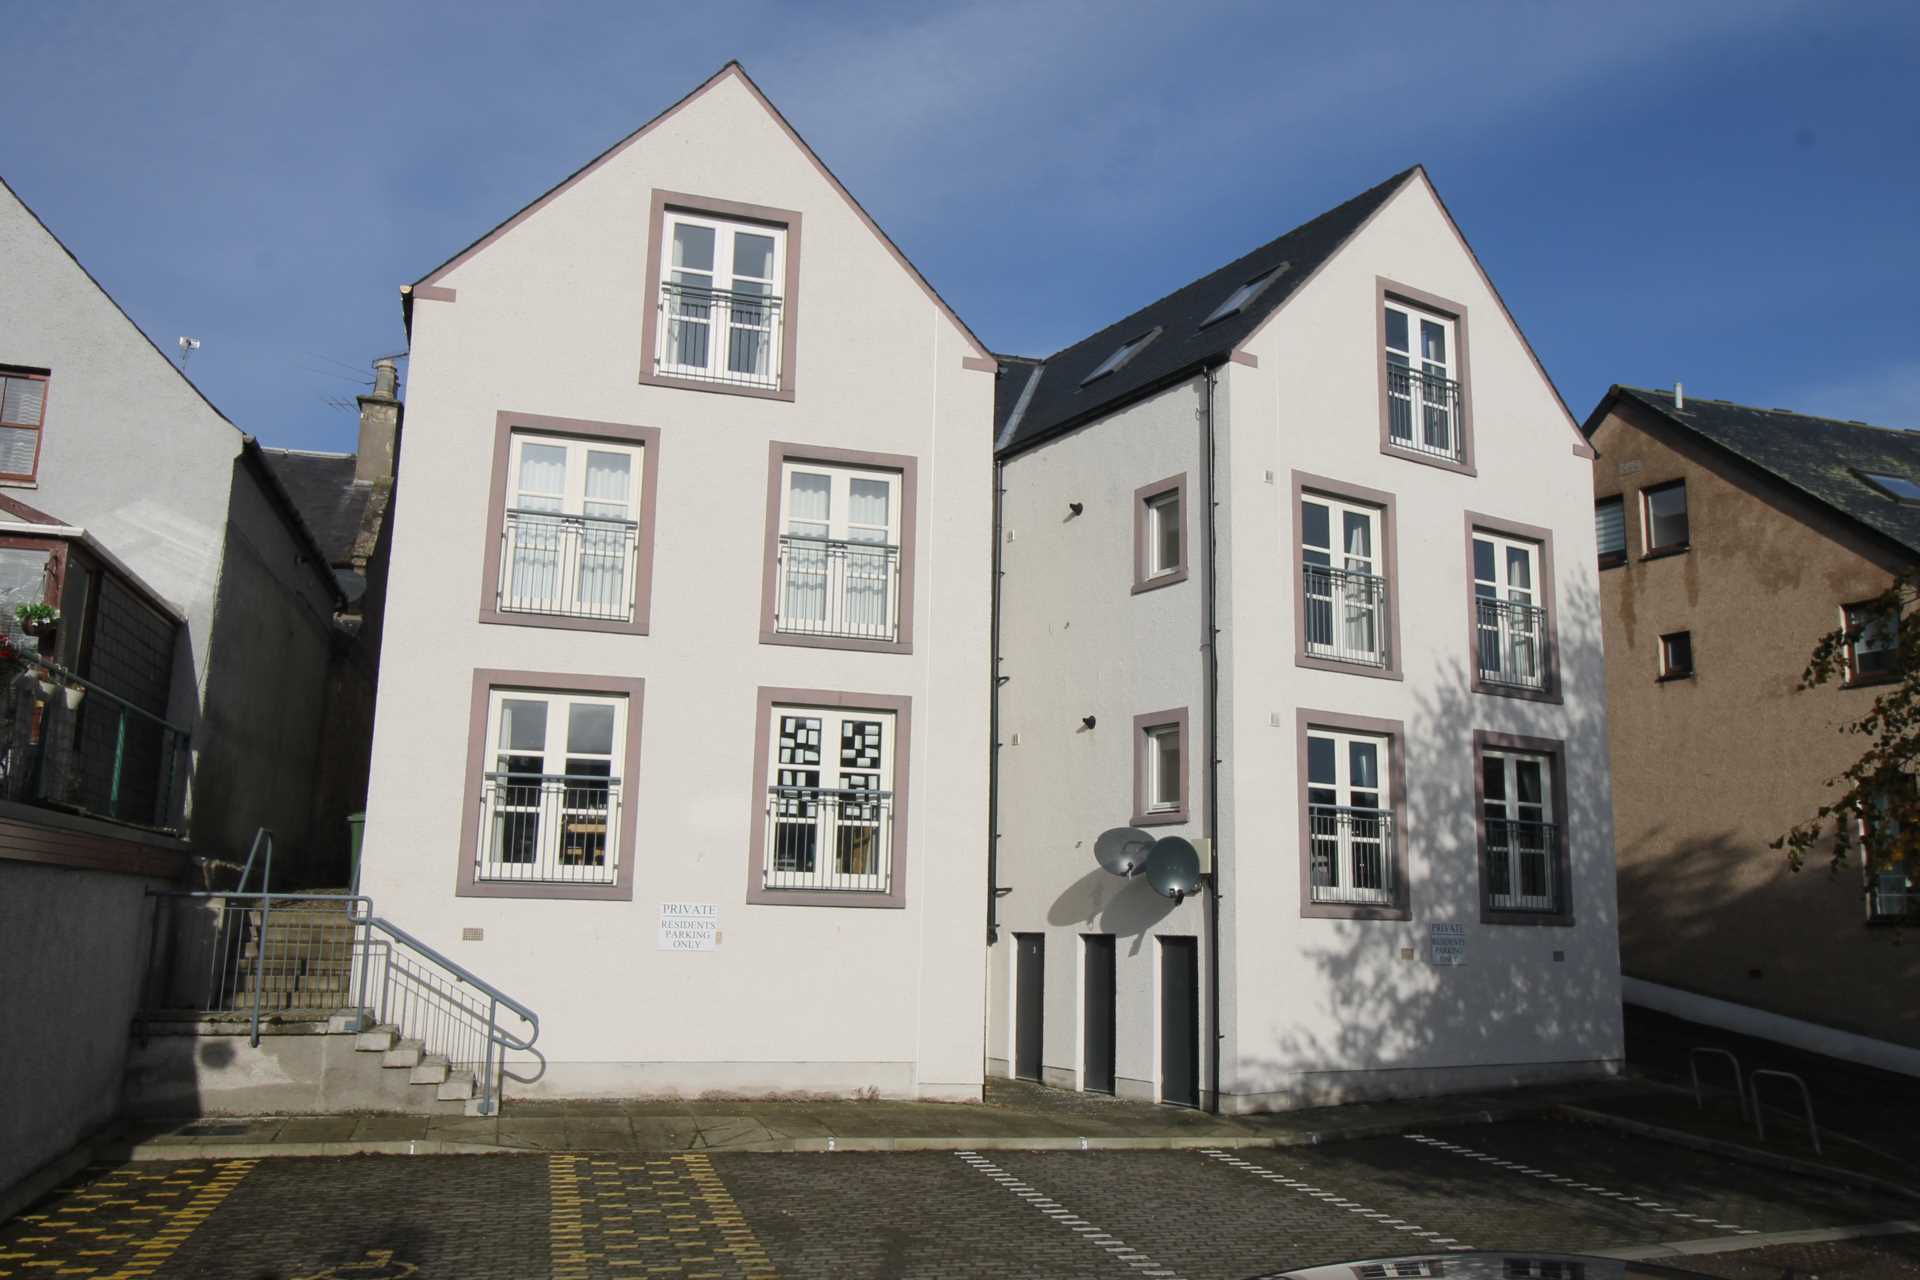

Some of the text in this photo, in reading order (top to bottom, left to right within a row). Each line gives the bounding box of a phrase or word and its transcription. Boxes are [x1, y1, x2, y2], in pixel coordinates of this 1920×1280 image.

[663, 904, 716, 914] PRIVATE
[661, 920, 716, 928] RESIDENTS
[1432, 924, 1464, 932] PRIVATE
[665, 930, 711, 939] PARKING
[672, 940, 704, 948] ONLY
